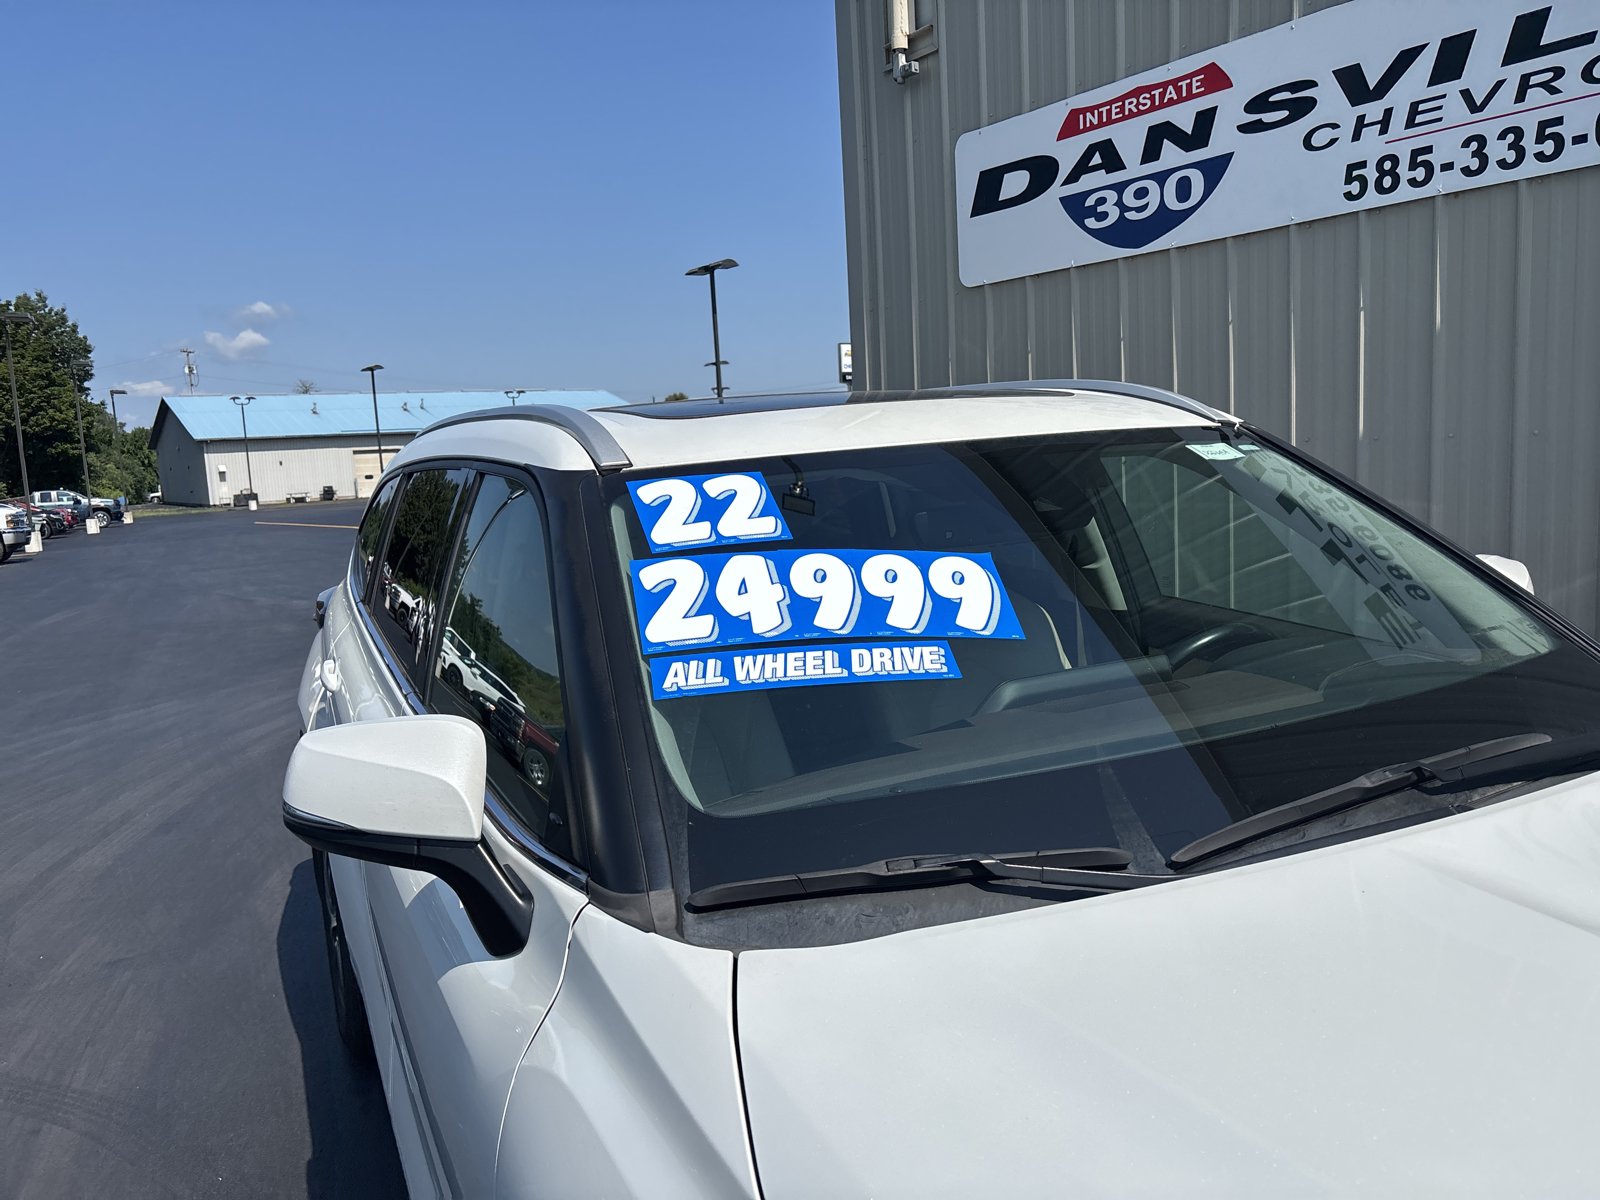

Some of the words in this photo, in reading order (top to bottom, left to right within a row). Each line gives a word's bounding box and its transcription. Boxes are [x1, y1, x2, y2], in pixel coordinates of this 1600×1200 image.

[1078, 74, 1206, 130] INTERSTATE
[1342, 110, 1600, 202] 585-335-
[1083, 166, 1205, 230] 390
[636, 473, 783, 547] 22
[637, 552, 1002, 647] 24999
[662, 657, 730, 692] ALL
[733, 649, 849, 684] WHEEL
[850, 645, 949, 675] DRIVE
